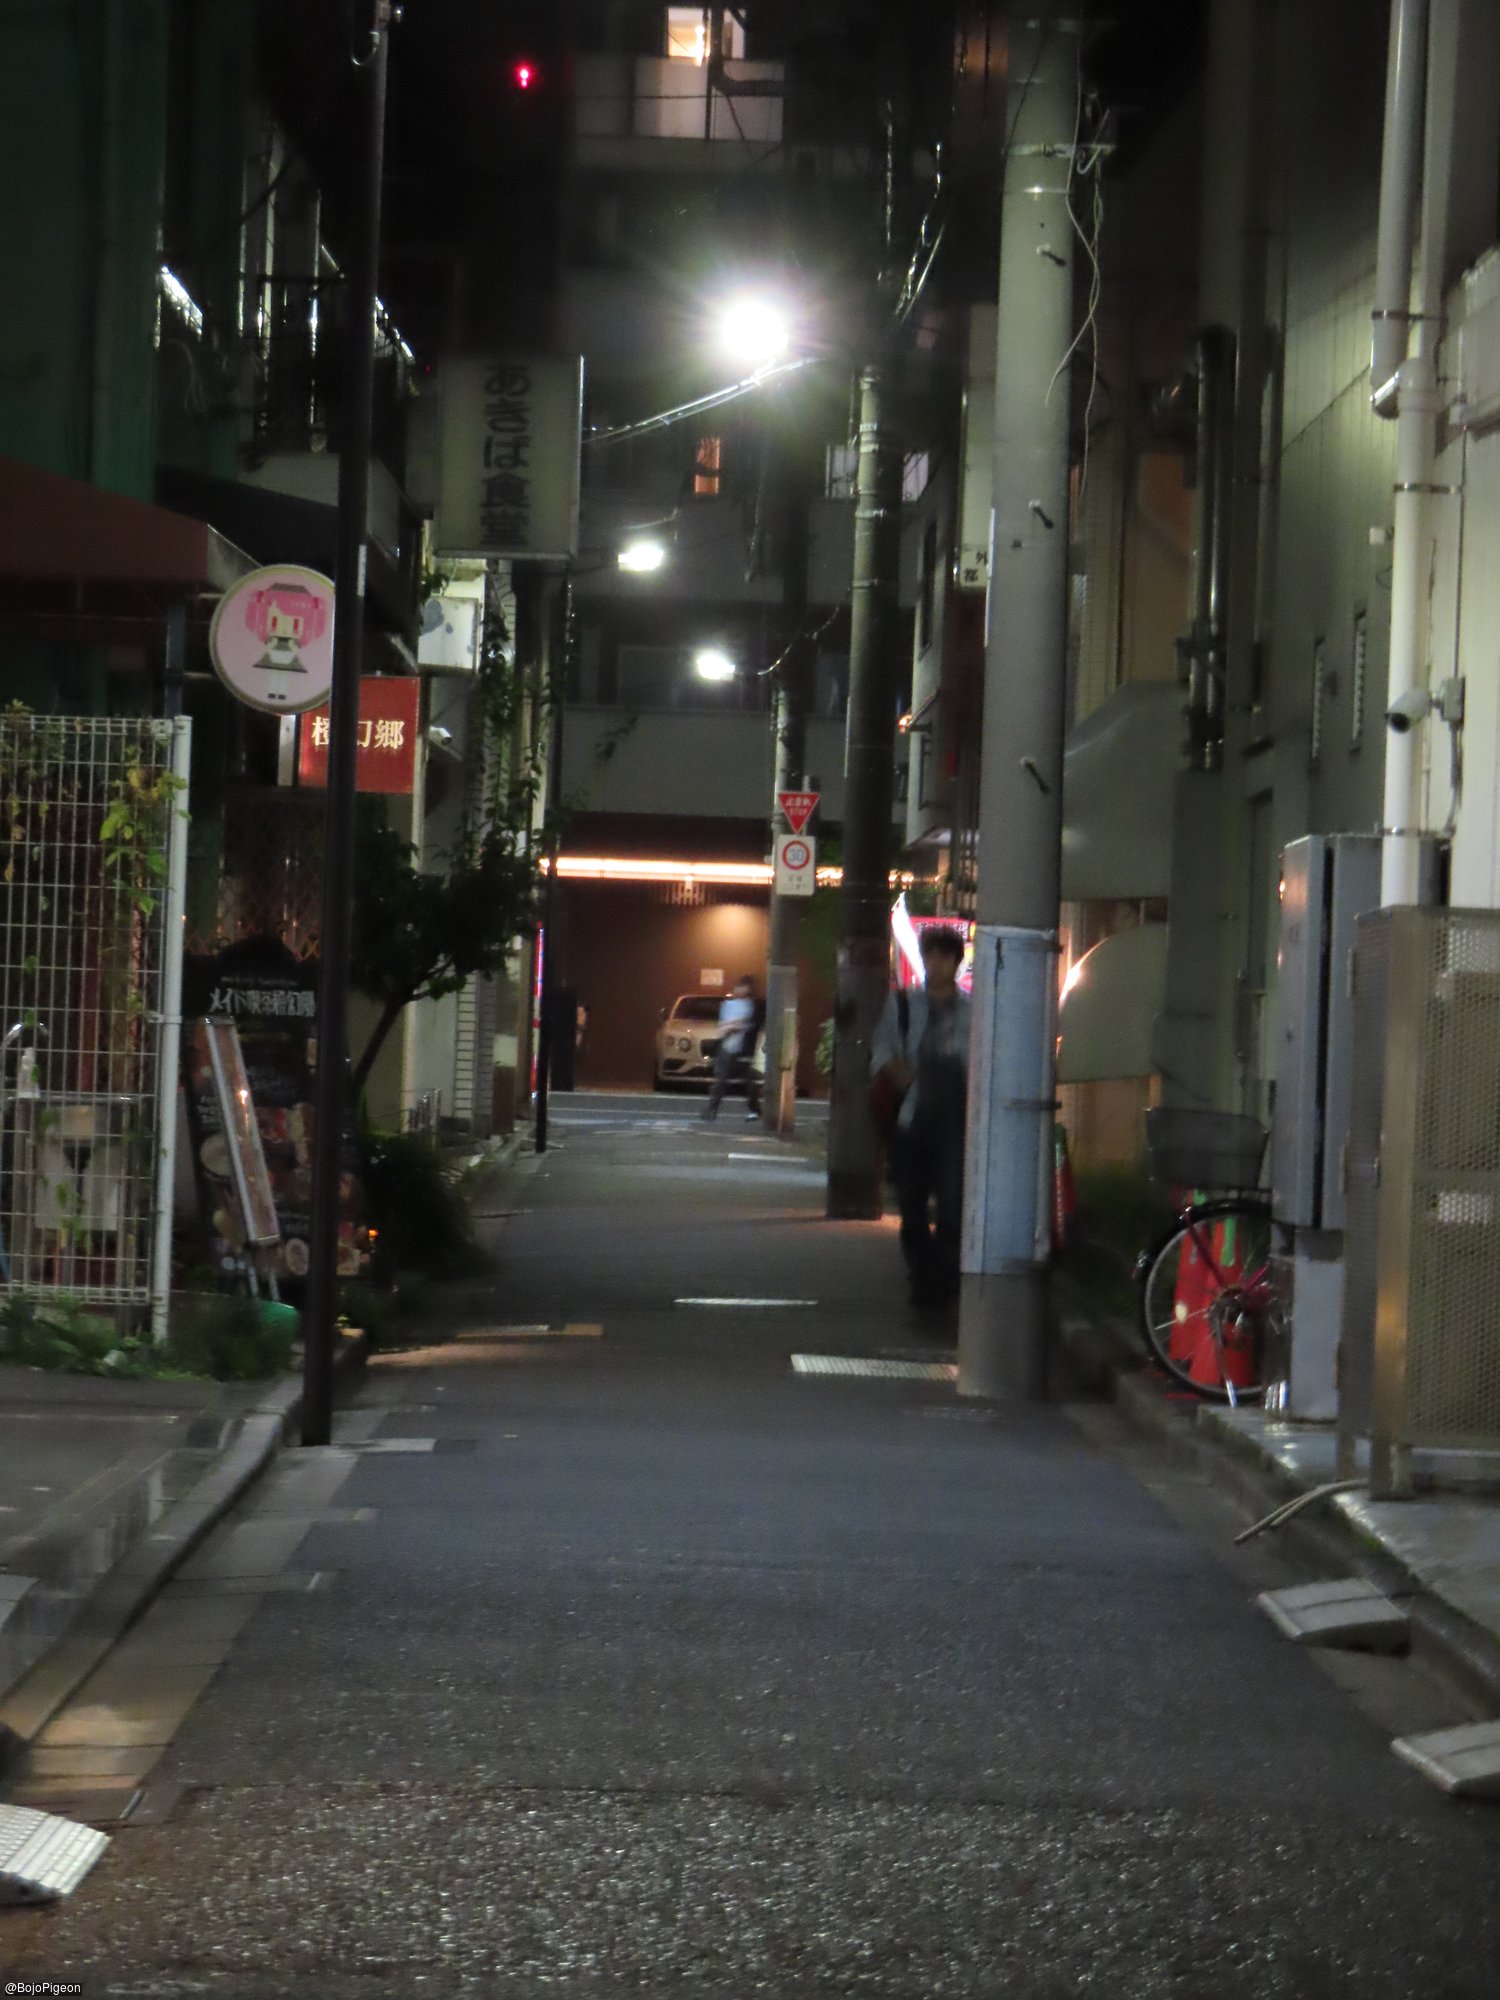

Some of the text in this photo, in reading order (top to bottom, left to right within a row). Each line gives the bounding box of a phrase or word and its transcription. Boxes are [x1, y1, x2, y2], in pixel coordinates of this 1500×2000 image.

[481, 363, 530, 546] あきば食堂
[785, 797, 811, 807] 止まれ
[789, 808, 807, 816] STOP
[789, 849, 804, 861] 30
